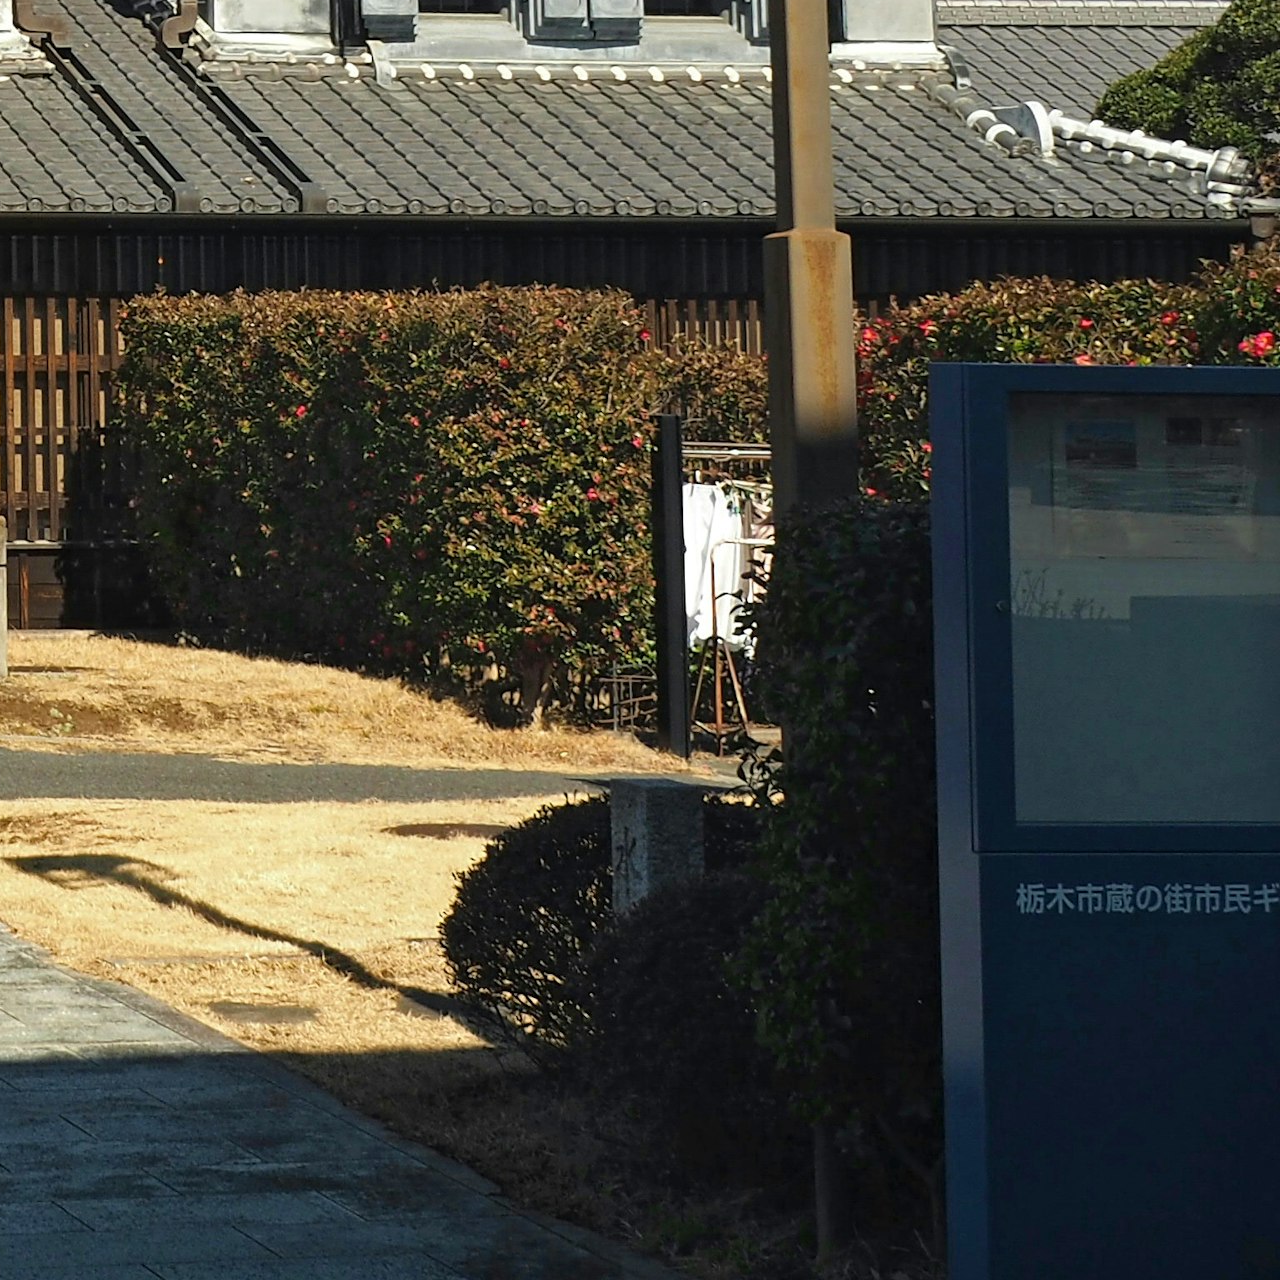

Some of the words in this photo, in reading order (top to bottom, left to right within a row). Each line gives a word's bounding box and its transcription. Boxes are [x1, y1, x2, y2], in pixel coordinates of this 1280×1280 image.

[1015, 882, 1280, 914] 栃木市蔵の街市民ギ
